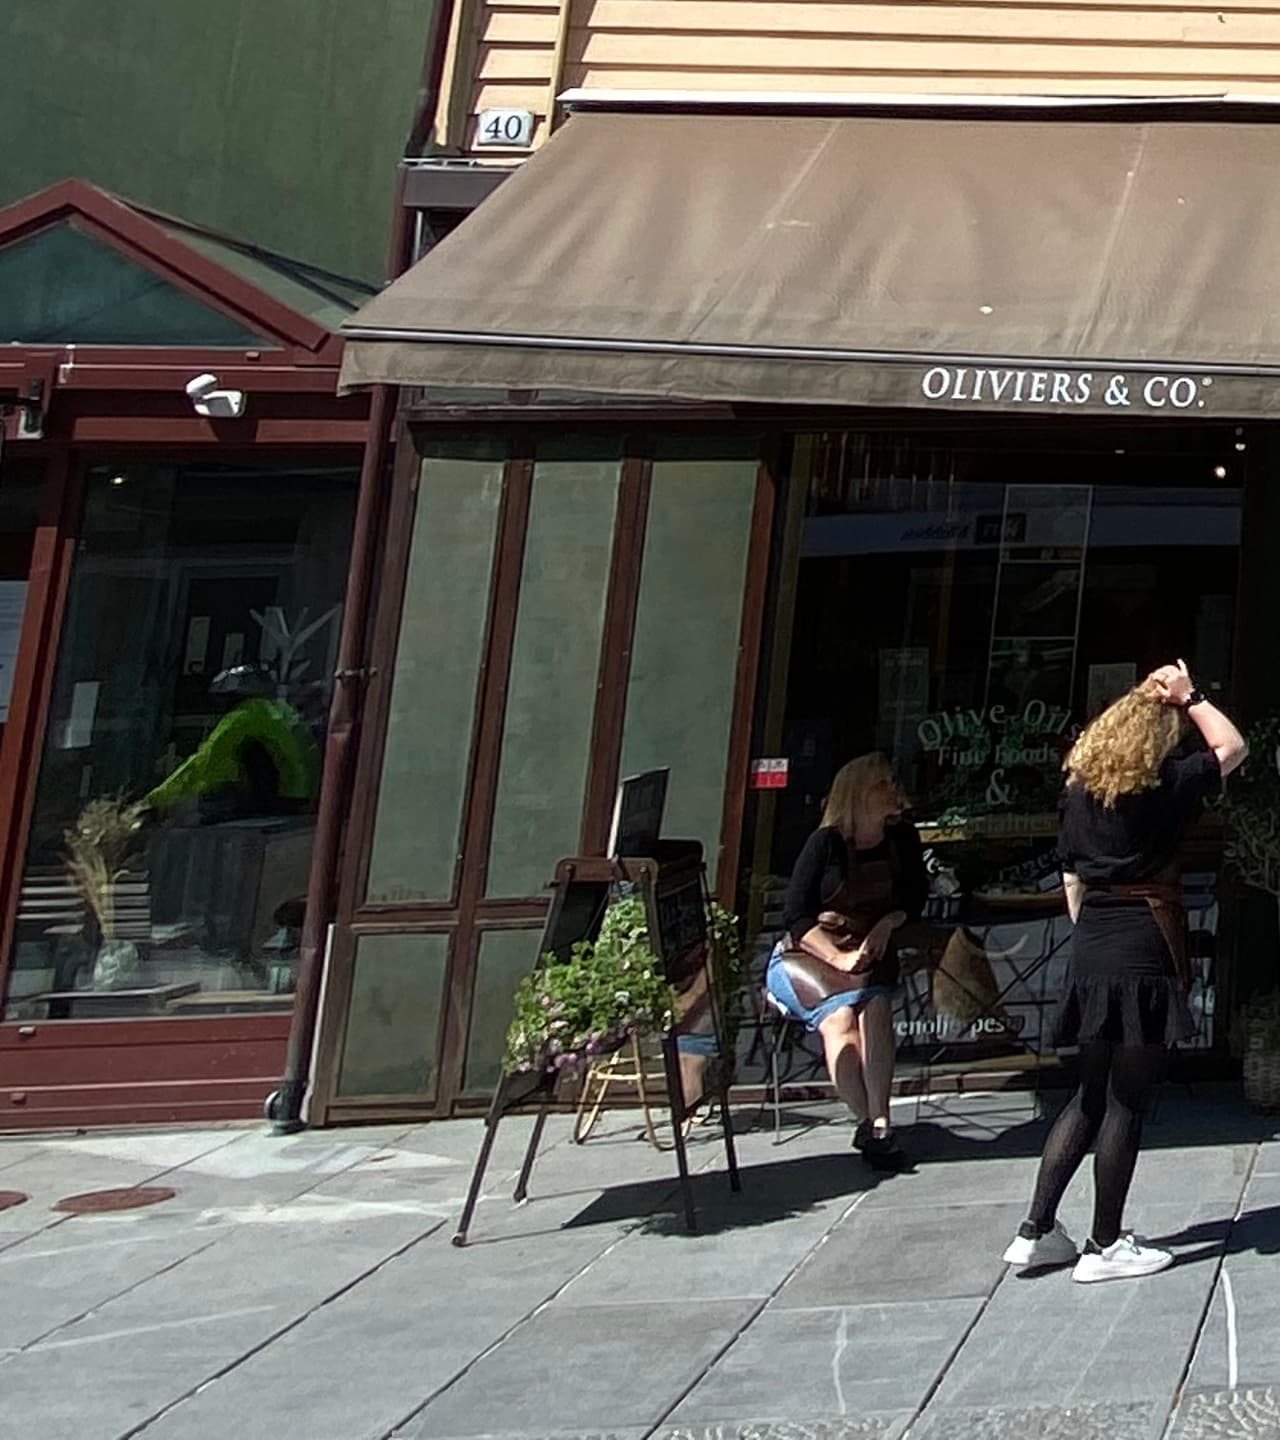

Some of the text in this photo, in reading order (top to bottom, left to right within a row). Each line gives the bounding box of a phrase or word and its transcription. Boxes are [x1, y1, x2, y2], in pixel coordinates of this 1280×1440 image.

[484, 115, 523, 141] 40
[922, 366, 1092, 404] OLIVIERS
[1104, 374, 1131, 406] &
[918, 698, 1084, 747] Olive Oils
[985, 767, 1010, 805] &
